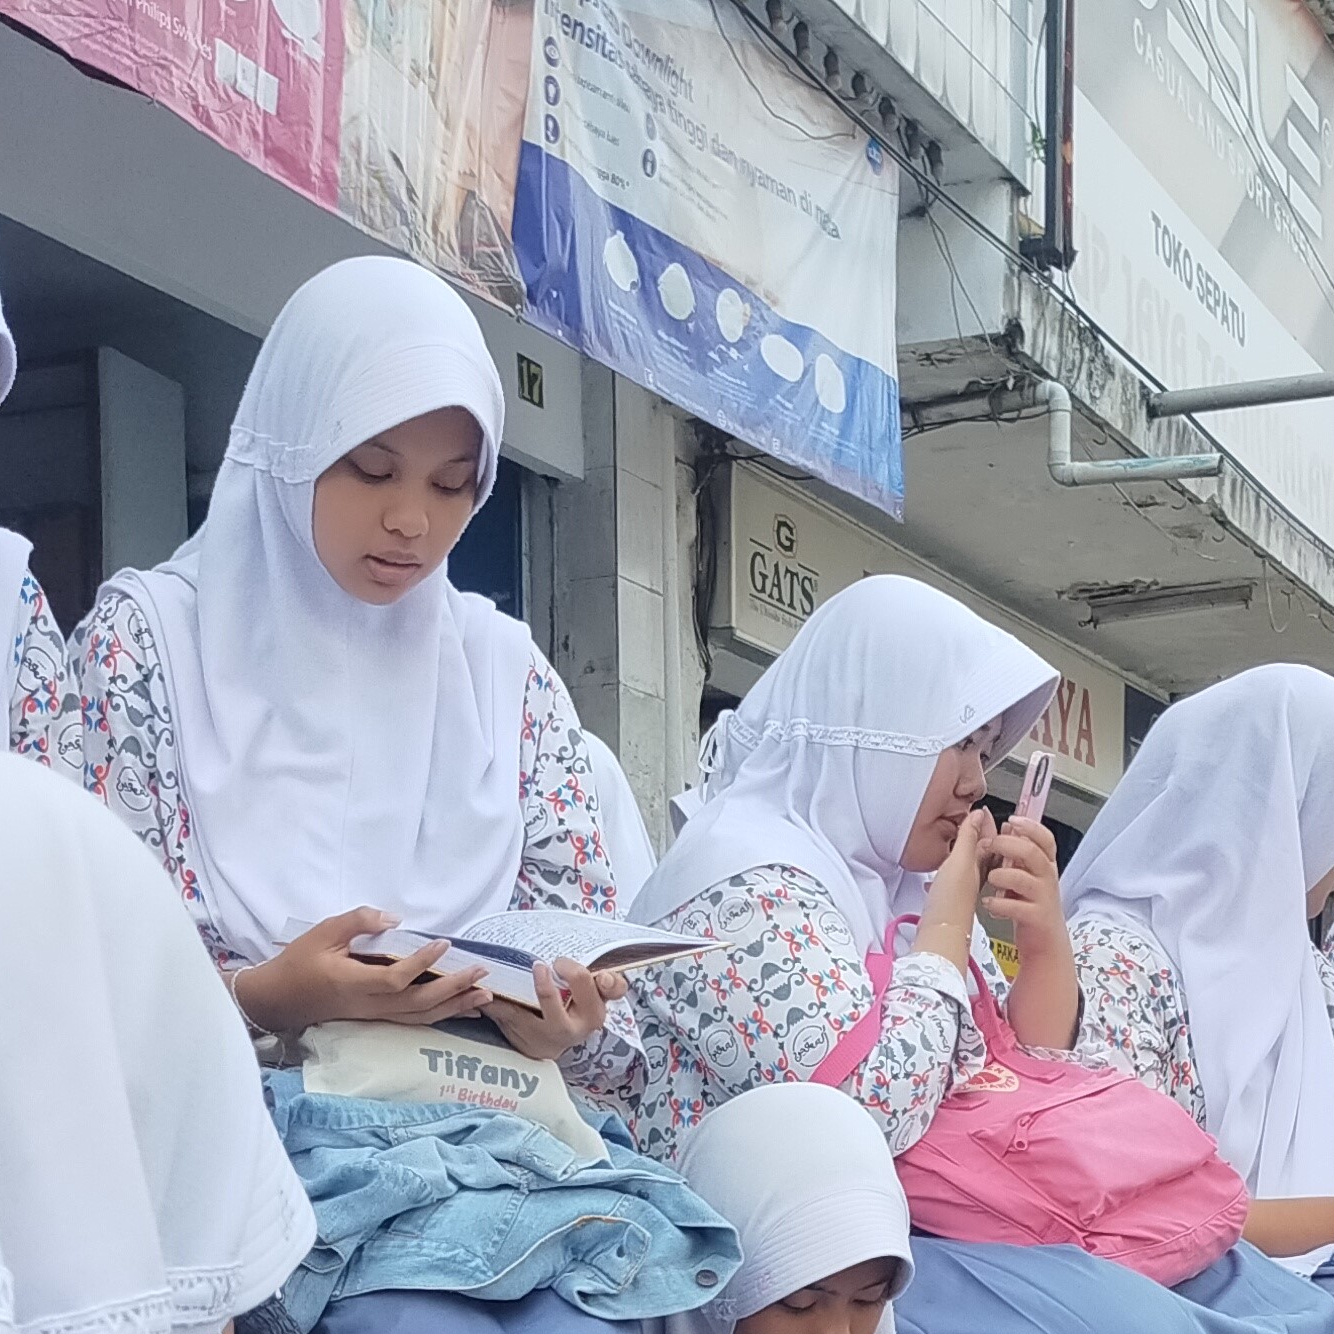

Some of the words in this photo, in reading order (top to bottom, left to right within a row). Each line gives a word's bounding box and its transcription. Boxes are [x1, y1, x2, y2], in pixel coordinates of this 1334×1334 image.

[621, 22, 693, 103] Downlight
[1133, 17, 1196, 124] CASUAL
[1197, 103, 1226, 161] AND
[1228, 142, 1272, 219] SPORT
[668, 98, 708, 152] tinggi
[800, 190, 813, 217] di
[1151, 210, 1194, 291] TOKO
[1196, 263, 1246, 348] SEPATU
[521, 359, 542, 404] 17
[776, 520, 795, 552] G
[749, 551, 815, 616] GATS
[419, 1048, 540, 1098] Tiffany
[440, 1084, 455, 1097] 1st
[458, 1088, 519, 1111] Birthday
